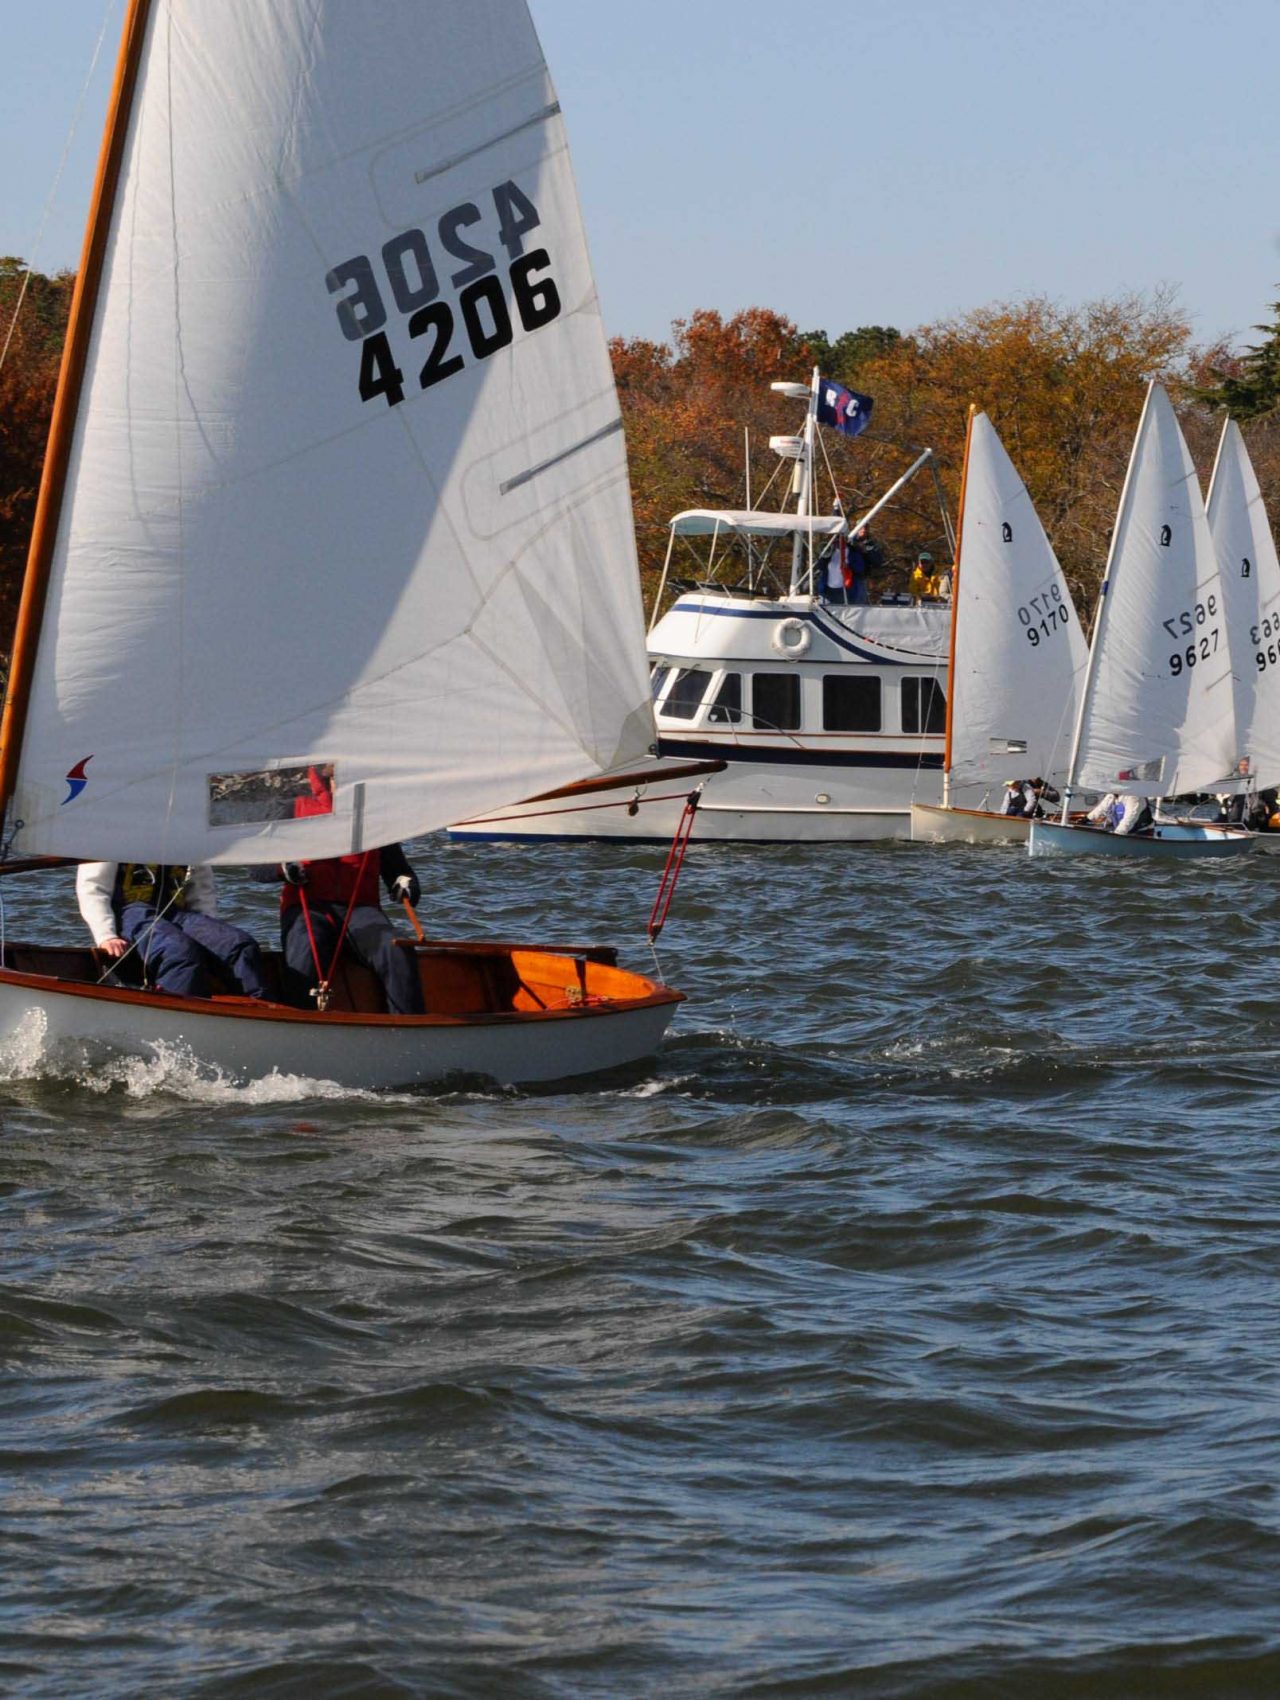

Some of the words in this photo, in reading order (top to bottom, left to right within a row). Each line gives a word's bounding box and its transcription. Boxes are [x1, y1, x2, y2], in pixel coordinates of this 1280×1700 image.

[358, 248, 562, 406] 4206
[825, 388, 837, 407] R
[846, 399, 860, 417] C
[1026, 604, 1069, 647] 9170
[1169, 629, 1219, 676] 9627
